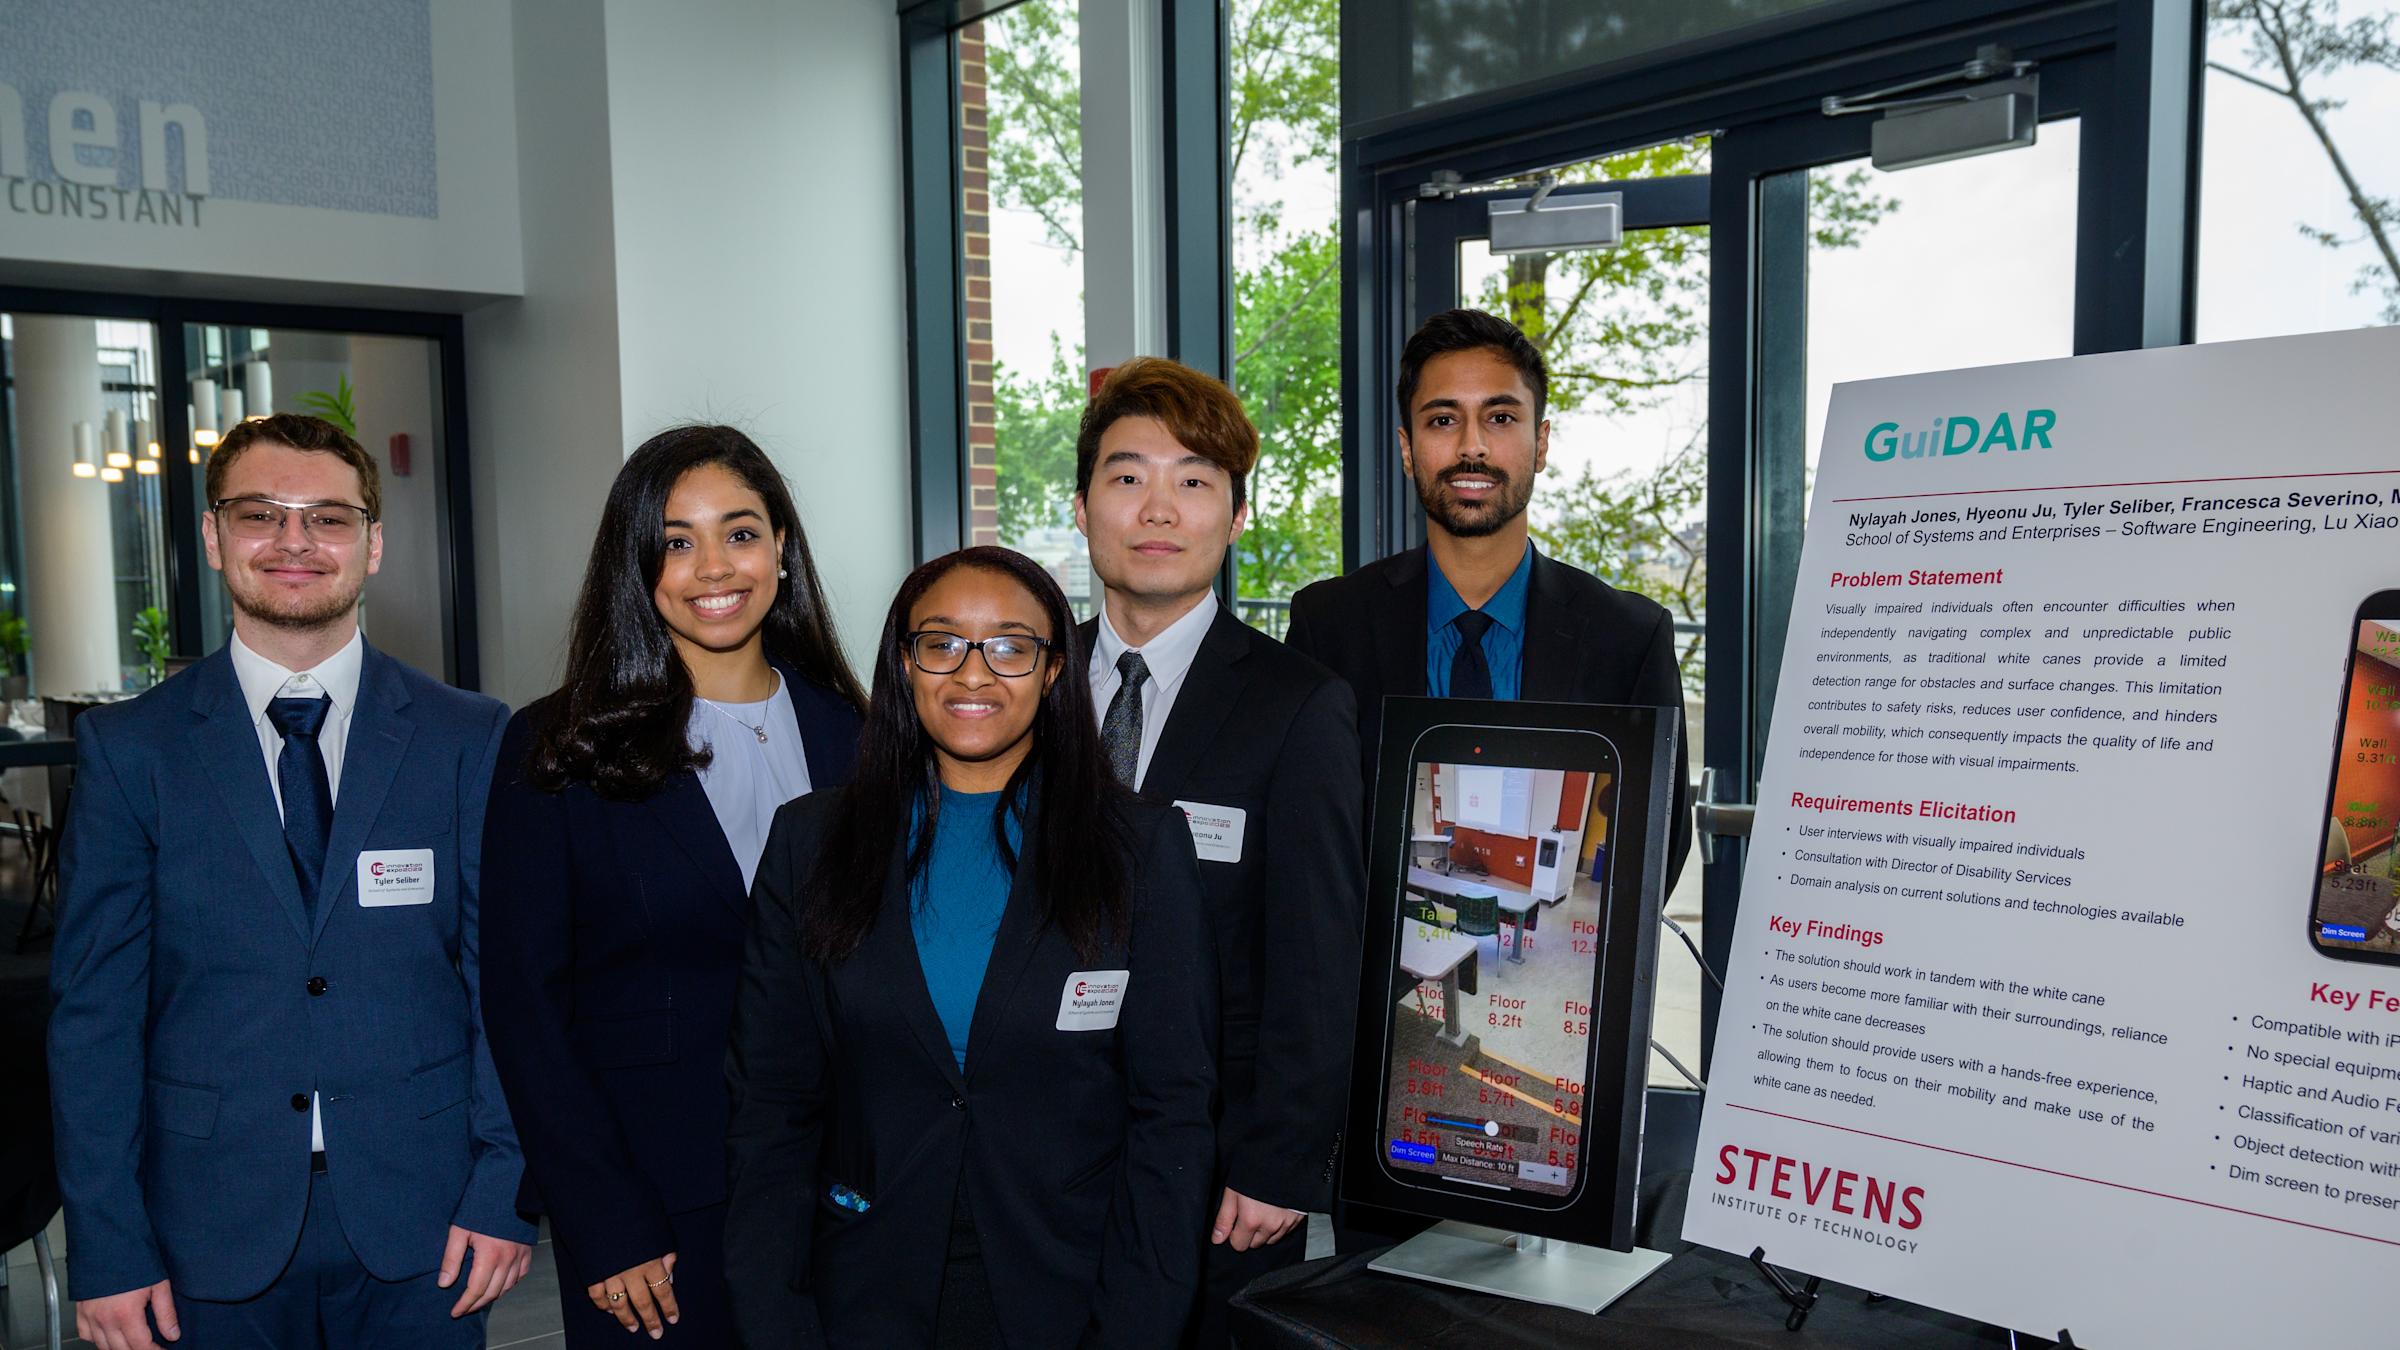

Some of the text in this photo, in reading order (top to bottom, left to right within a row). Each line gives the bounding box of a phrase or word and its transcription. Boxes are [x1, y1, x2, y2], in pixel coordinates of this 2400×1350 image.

[9, 178, 207, 229] CONSTANT
[1863, 408, 2057, 463] GuiDAR
[1849, 490, 2383, 530] Nylayah Jones, Hyeonu Ju, Tyler Seliber, Francesca Severino,
[1845, 513, 2399, 547] School of Systems and Enterprises Software Engineering, Lu Xiao
[1830, 568, 2004, 588] Problem Statement
[1826, 599, 2235, 617] Visually impaired individuals often encounter difficulties when
[1820, 625, 2232, 642] independently navigating complex and unpredictable public
[1816, 651, 2227, 668] environments, as traditional white canes provide a limited
[1812, 675, 2222, 695] detection range for obstacles and surface changes. This limitation
[1791, 791, 2016, 824] Requirements Elicitation
[1193, 831, 1223, 841] eonu Ju
[1799, 824, 2086, 860] User interviews with visually impaired individuals
[374, 877, 420, 887] Tyler Seliber
[1794, 849, 2072, 887] Consultation with Director of Disability Services
[1572, 920, 1599, 935] Flo
[1769, 915, 1884, 948] Key Findings
[2321, 926, 2366, 939] Dim Screen
[1775, 948, 2105, 1006] The solution should work in tandem with the white cane
[1072, 999, 1098, 1008] Nylayah
[1489, 994, 1527, 1010] Floor
[1769, 974, 2168, 1045] As users become more familiar with their surroundings, reliance
[2310, 982, 2361, 1012] Key
[1488, 1012, 1523, 1028] 8.2ft
[1563, 1020, 1588, 1036] 8.5
[1765, 1001, 1926, 1035] on the white cane decreases
[2251, 1015, 2342, 1040] Compatible
[2347, 1029, 2380, 1046] with
[2246, 1044, 2270, 1061] No
[2273, 1051, 2331, 1070] special
[1480, 1069, 1521, 1087] Floor
[2242, 1074, 2380, 1110] Haptic and Audio
[1479, 1088, 1515, 1107] 5.7ft
[2238, 1104, 2344, 1135] Classification
[2348, 1125, 2367, 1139] of
[1391, 1144, 1435, 1160] Dim Screen
[1455, 1137, 1485, 1150] Speech
[1486, 1142, 1504, 1153] Rate
[2233, 1134, 2400, 1177] Object detection with
[1442, 1152, 1515, 1173] Max Distance: 10 ft
[1716, 1144, 1926, 1231] STEVENS
[2229, 1164, 2260, 1183] Dim
[2264, 1174, 2319, 1195] screen
[2324, 1183, 2340, 1199] to
[1712, 1192, 1918, 1254] INSTITUTE OF TECHNOLOGY
